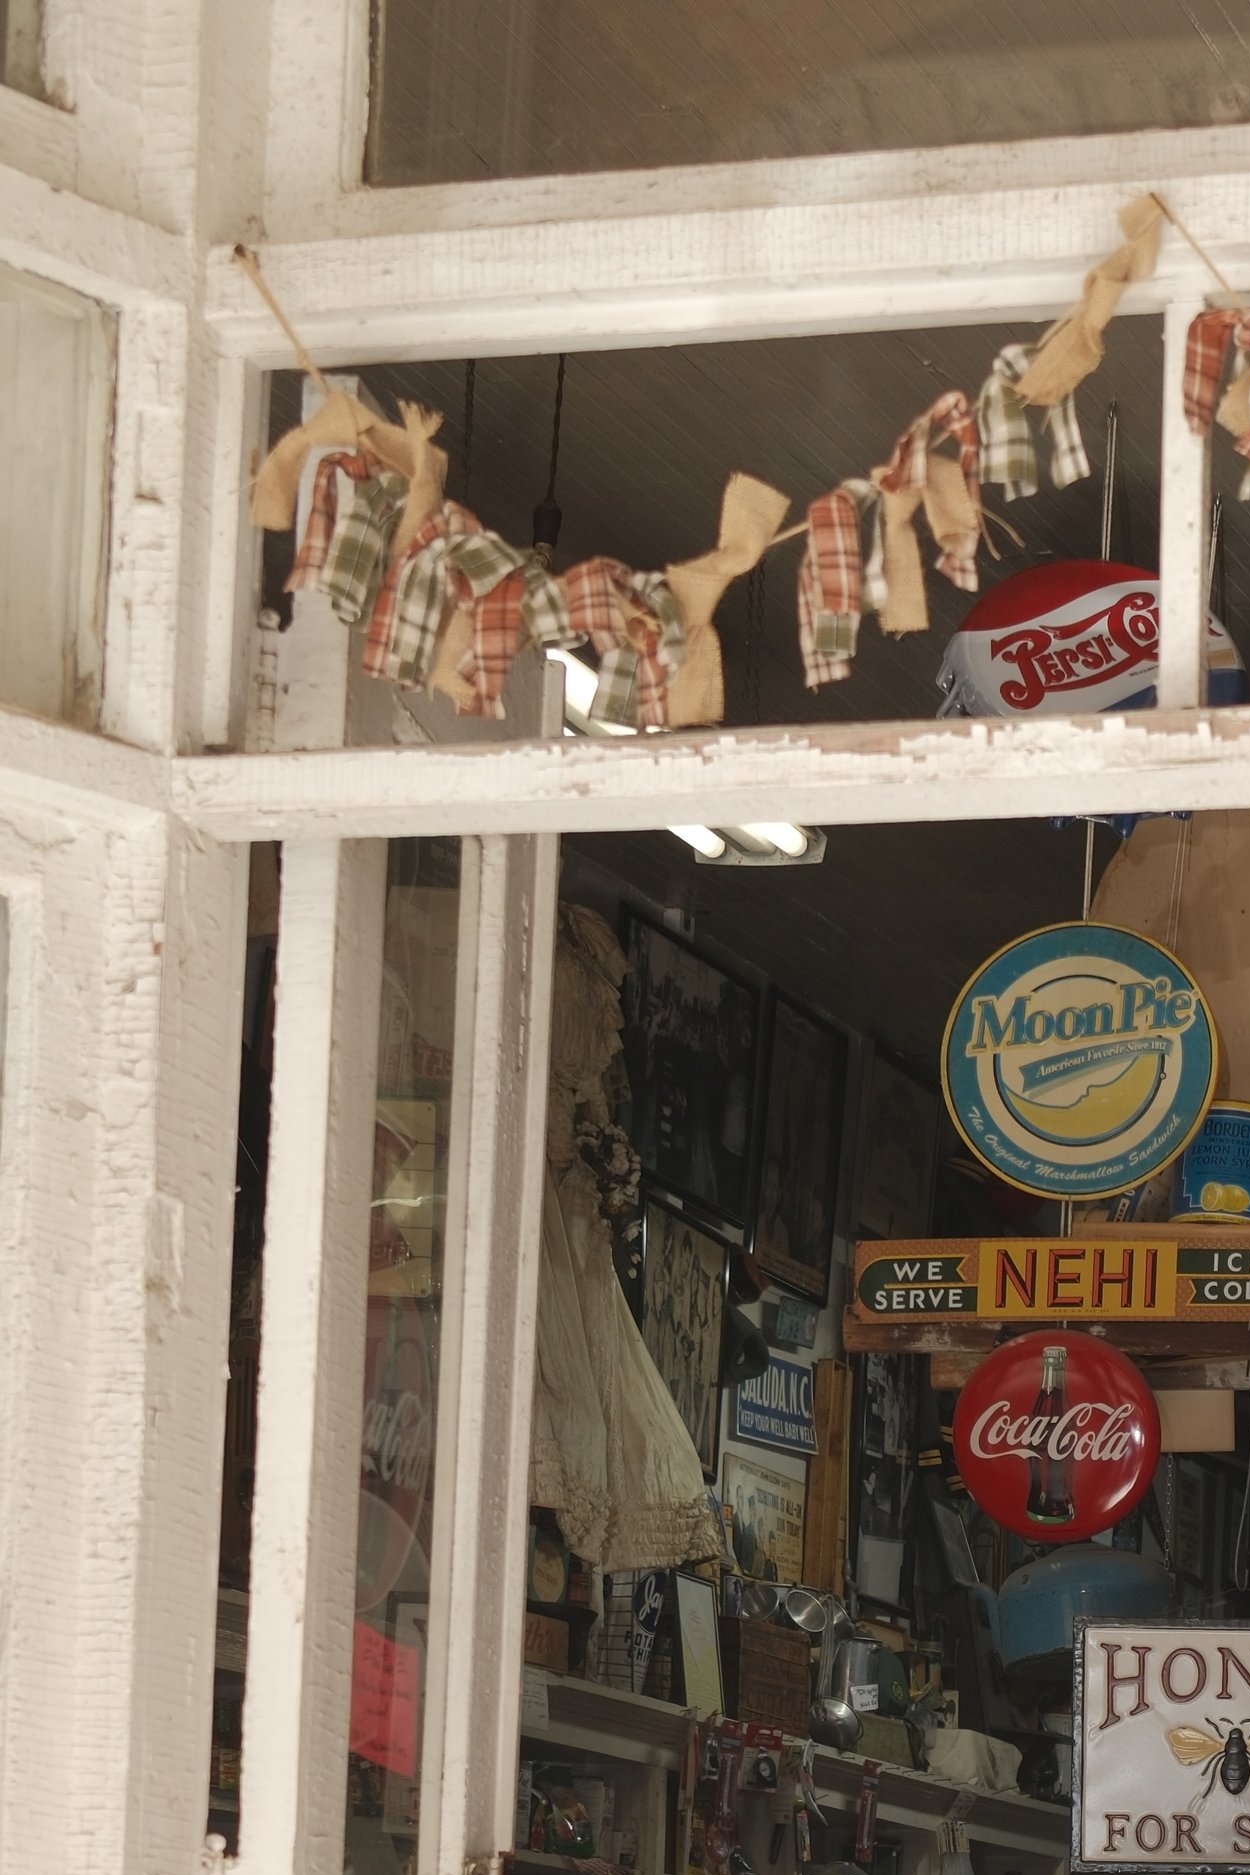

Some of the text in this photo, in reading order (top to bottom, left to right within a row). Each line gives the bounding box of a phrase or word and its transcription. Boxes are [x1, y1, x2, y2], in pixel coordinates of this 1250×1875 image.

[1035, 1040, 1168, 1079] American Favorite Since 1917
[967, 1105, 1183, 1181] The Original Marshmallow Sandwich
[1191, 1144, 1231, 1156] LEMON
[1197, 1154, 1228, 1167] CORN
[892, 1259, 944, 1282] WE
[993, 1247, 1160, 1310] NEHI
[873, 1288, 964, 1311] SERVE
[969, 1399, 1136, 1463] Coca-Cola
[1103, 1812, 1203, 1854] FOR
